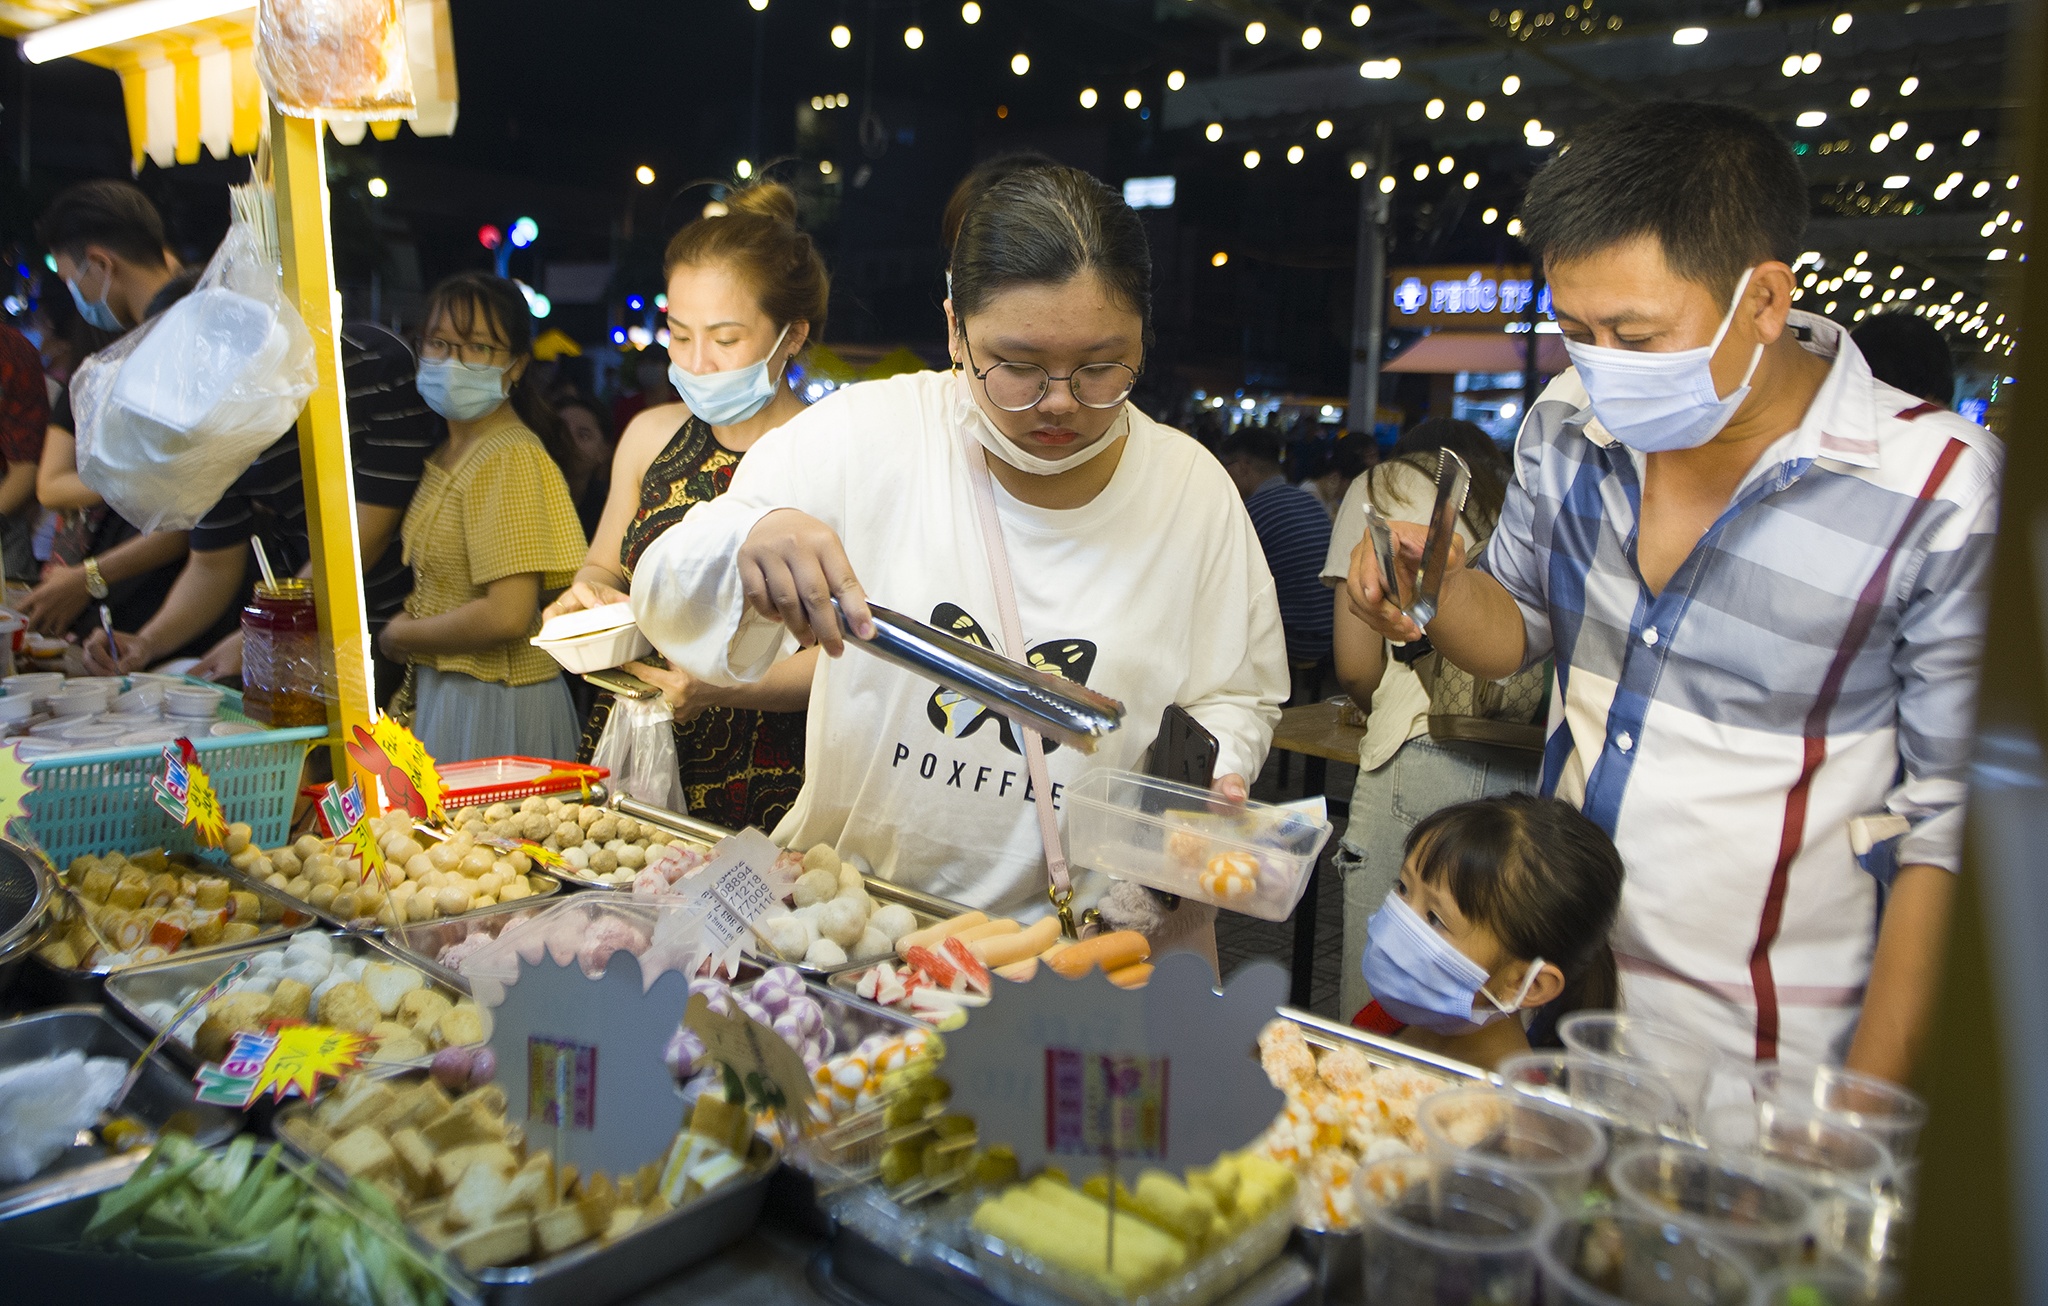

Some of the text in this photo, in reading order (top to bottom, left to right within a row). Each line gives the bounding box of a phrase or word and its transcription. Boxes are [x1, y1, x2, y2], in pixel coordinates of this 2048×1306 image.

[720, 866, 753, 898] 08894
[728, 875, 762, 907] 71218
[737, 883, 770, 916] 77009
